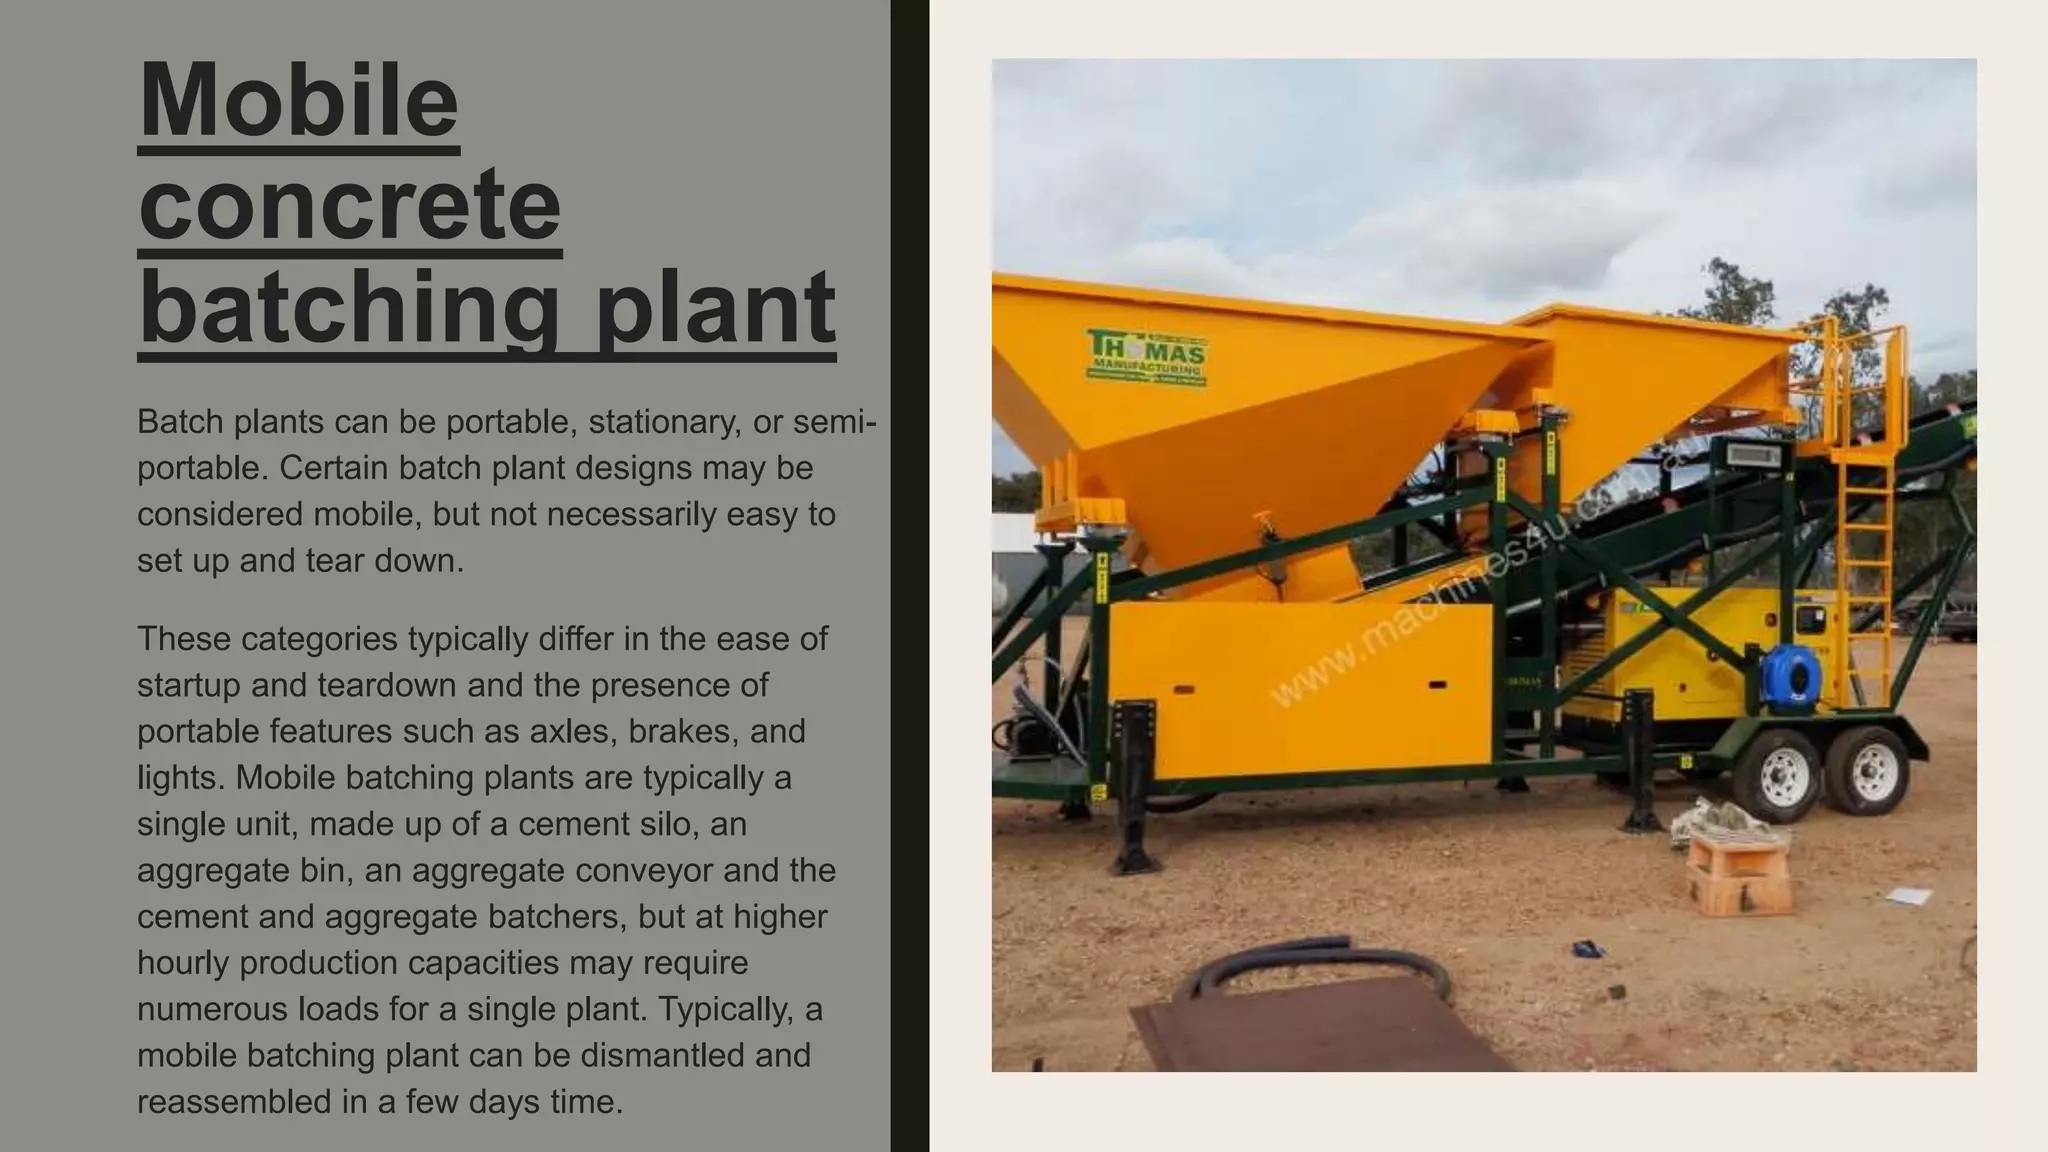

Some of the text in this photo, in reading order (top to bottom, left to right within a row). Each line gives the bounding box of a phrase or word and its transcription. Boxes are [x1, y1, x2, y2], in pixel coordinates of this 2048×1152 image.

[142, 60, 459, 137] Mobile
[140, 165, 562, 240] concrete
[142, 267, 837, 354] batching plant
[138, 407, 877, 441] Batch plants can be portable, stationary, or semi-
[138, 453, 814, 487] portable. Certain batch plant designs may be
[137, 499, 836, 534] considered mobile, but not necessarily easy to
[137, 546, 463, 580] set up and tear down.
[136, 624, 831, 658] These categories typically differ in the ease of
[137, 670, 771, 704] startup and teardown and the presence of
[138, 717, 806, 751] portable features such as axles, brakes, and
[138, 763, 792, 797] lights. Mobile batching plants are typically a
[137, 809, 747, 843] single unit, made up of a cement silo, an
[137, 856, 837, 890] aggregate bin, an aggregate conveyor and the
[137, 902, 829, 936] cement and aggregate batchers, but at higher
[138, 948, 749, 982] hourly production capacities may require
[138, 994, 823, 1029] numerous loads for a single plant. Typically, a
[138, 1041, 811, 1075] mobile batching plant can be dismantled and
[138, 1087, 623, 1121] reassembled in a few days time.
